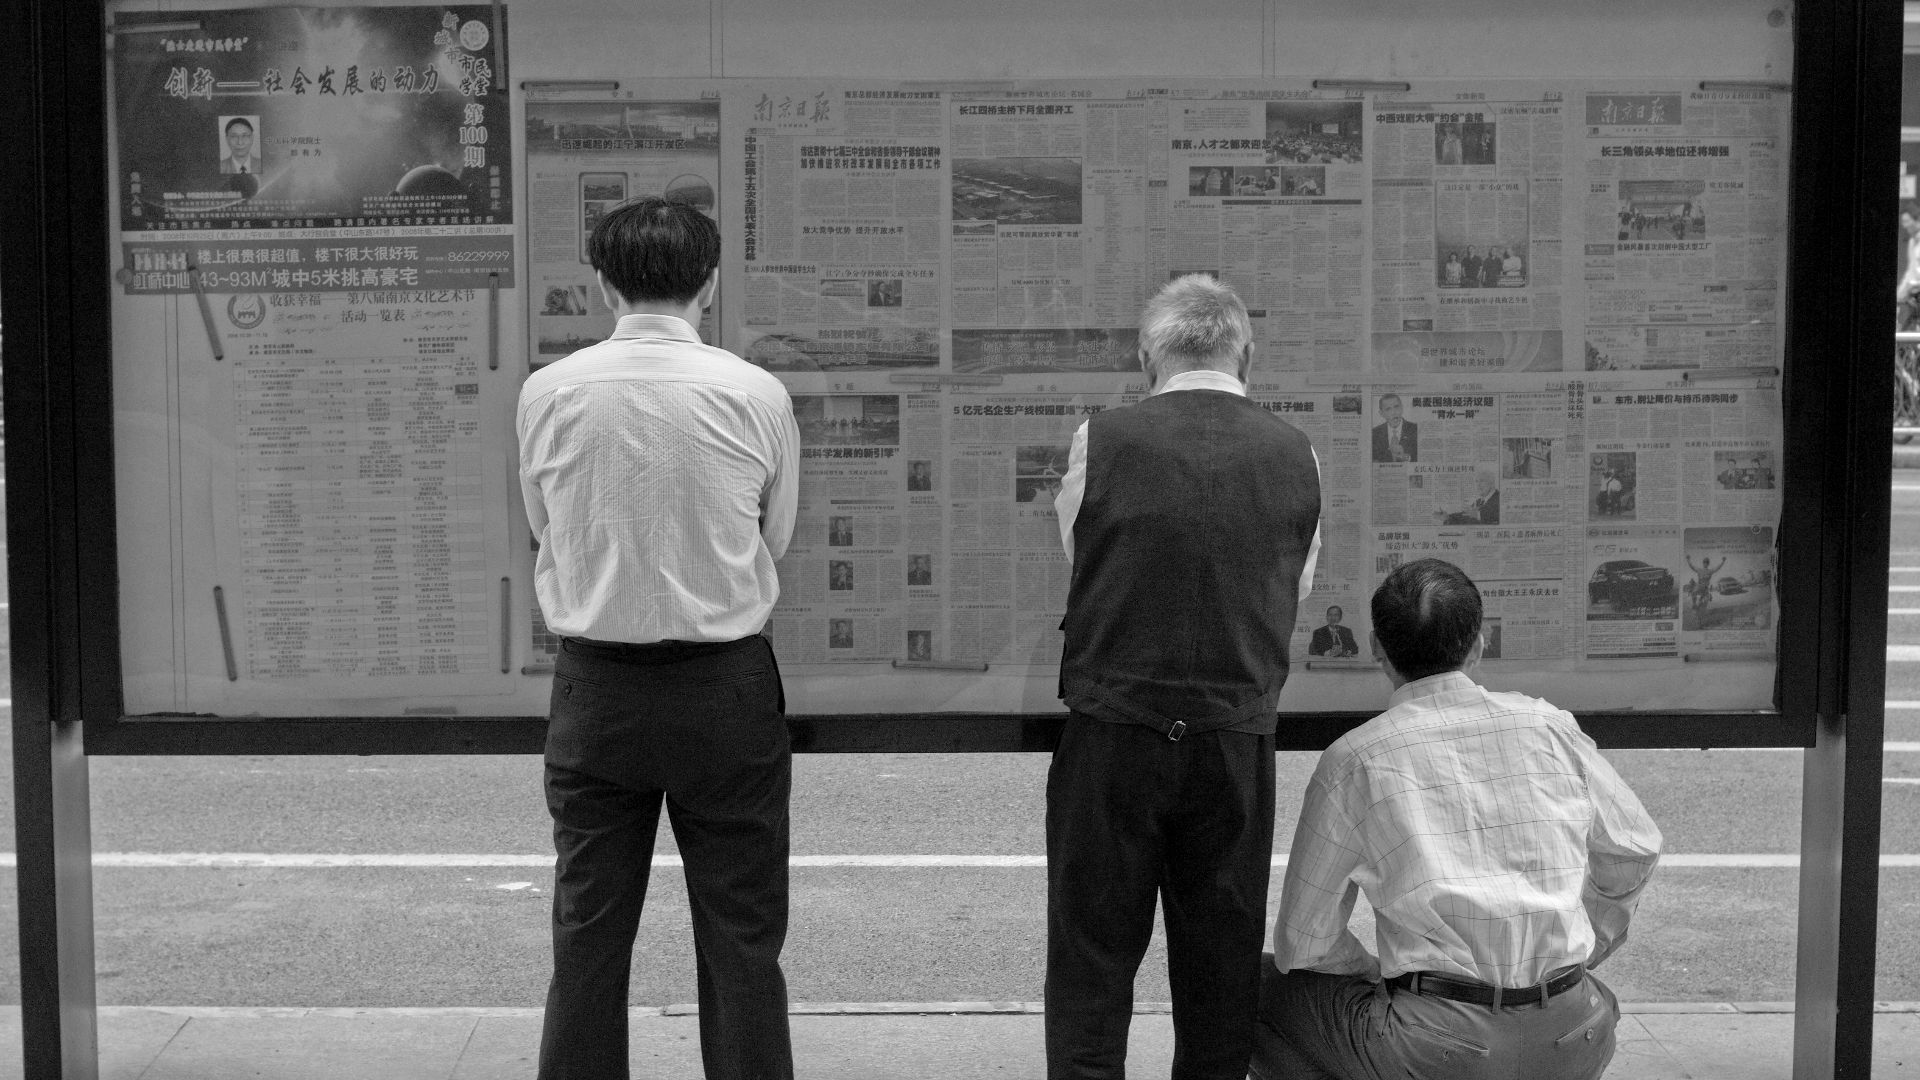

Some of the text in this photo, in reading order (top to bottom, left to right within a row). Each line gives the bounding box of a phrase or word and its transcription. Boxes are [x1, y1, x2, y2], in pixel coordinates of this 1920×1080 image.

[164, 63, 439, 100] 创新——社会发展的动力
[959, 105, 1074, 115] 长江四桥主桥下月全面开工
[459, 104, 488, 169] 第100期
[1601, 146, 1730, 157] 长三角领头羊地位还将增强
[802, 226, 904, 235] 放大竞争优势 提升开放水平
[447, 250, 510, 263] 86229999
[133, 272, 191, 290] 虹桥中心
[341, 309, 405, 323] 活动一览表
